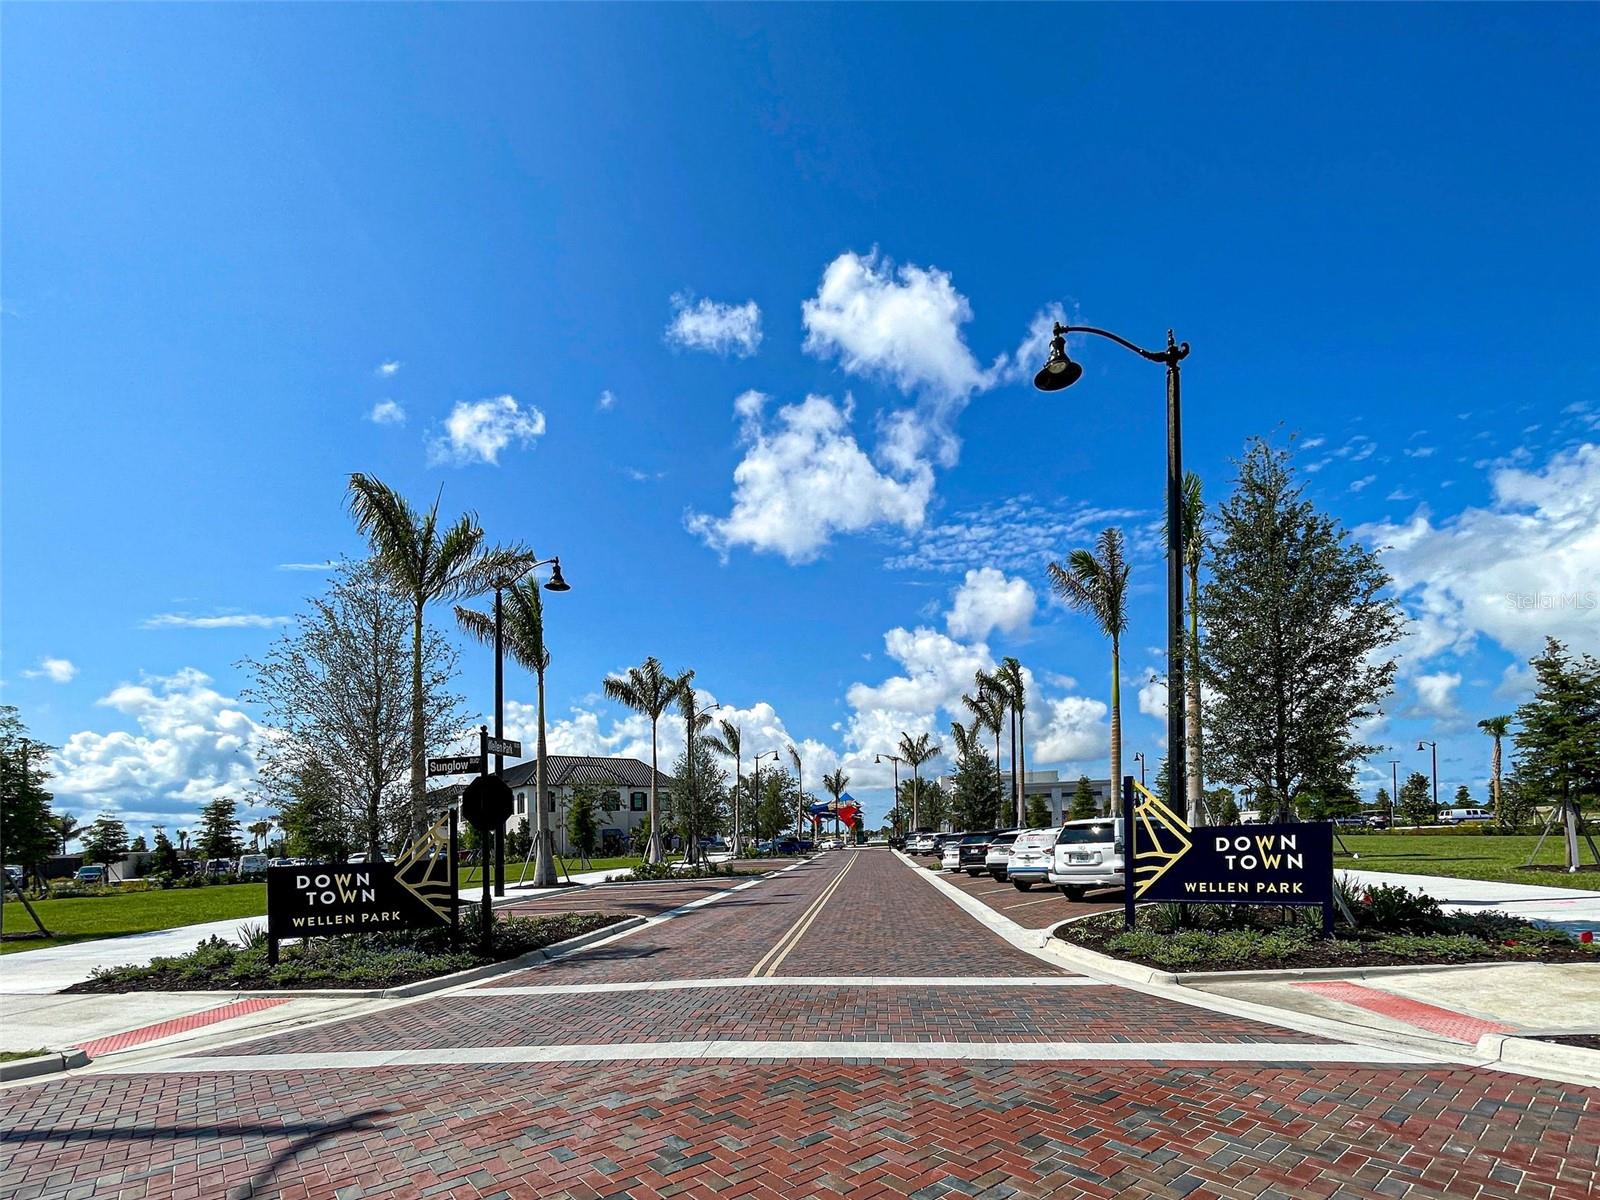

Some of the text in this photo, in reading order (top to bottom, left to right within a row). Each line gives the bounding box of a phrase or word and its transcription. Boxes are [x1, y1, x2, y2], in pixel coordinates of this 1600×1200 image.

[503, 742, 513, 754] Park
[430, 760, 469, 774] Sunglow
[1215, 834, 1297, 852] DOWN
[1225, 853, 1304, 871] TOWN
[296, 872, 370, 889] DOWN
[1184, 882, 1304, 894] WELLEN PARK
[306, 888, 376, 906] TOWN
[292, 911, 401, 928] WELLEN PARK
